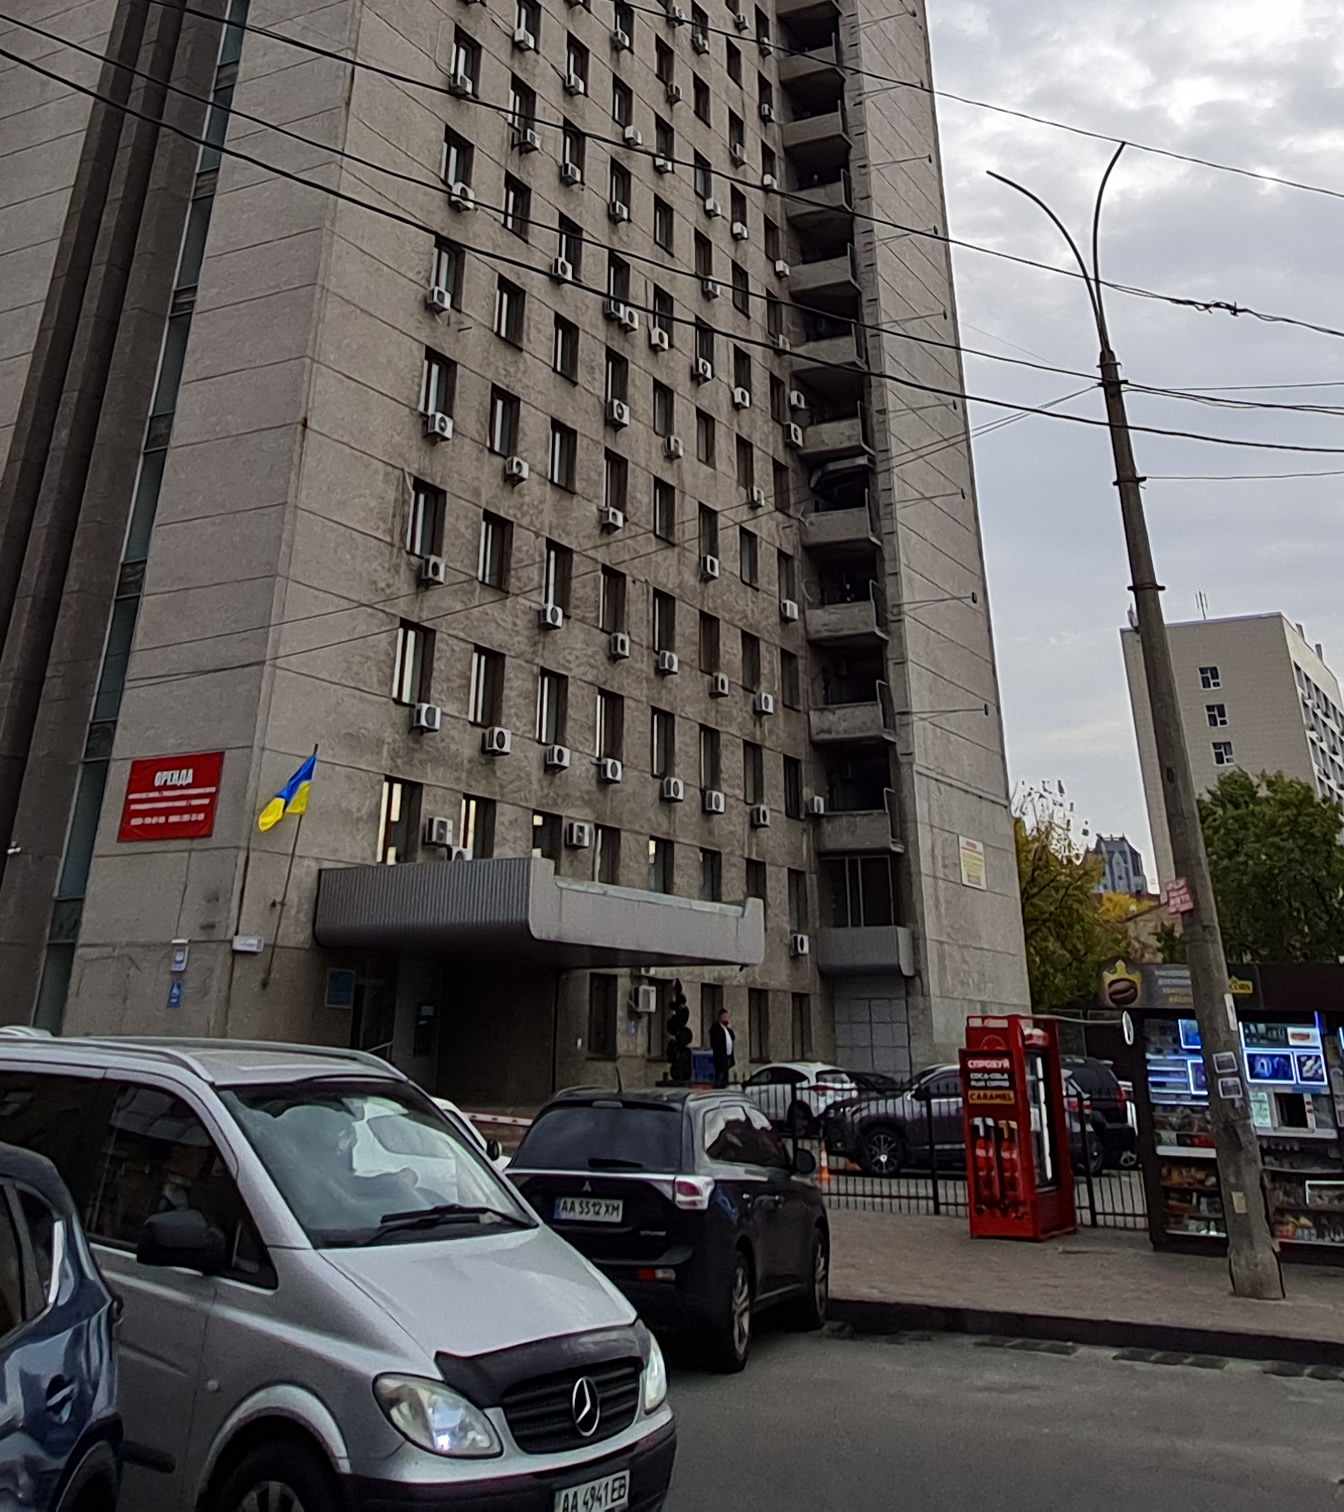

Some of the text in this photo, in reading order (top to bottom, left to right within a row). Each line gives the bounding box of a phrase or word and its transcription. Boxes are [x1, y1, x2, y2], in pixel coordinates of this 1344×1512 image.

[154, 768, 193, 787] ОРЕНДА
[968, 1058, 1010, 1069] СПРОБУЙ
[969, 1092, 1013, 1102] CARAMEL
[561, 1199, 576, 1213] AA
